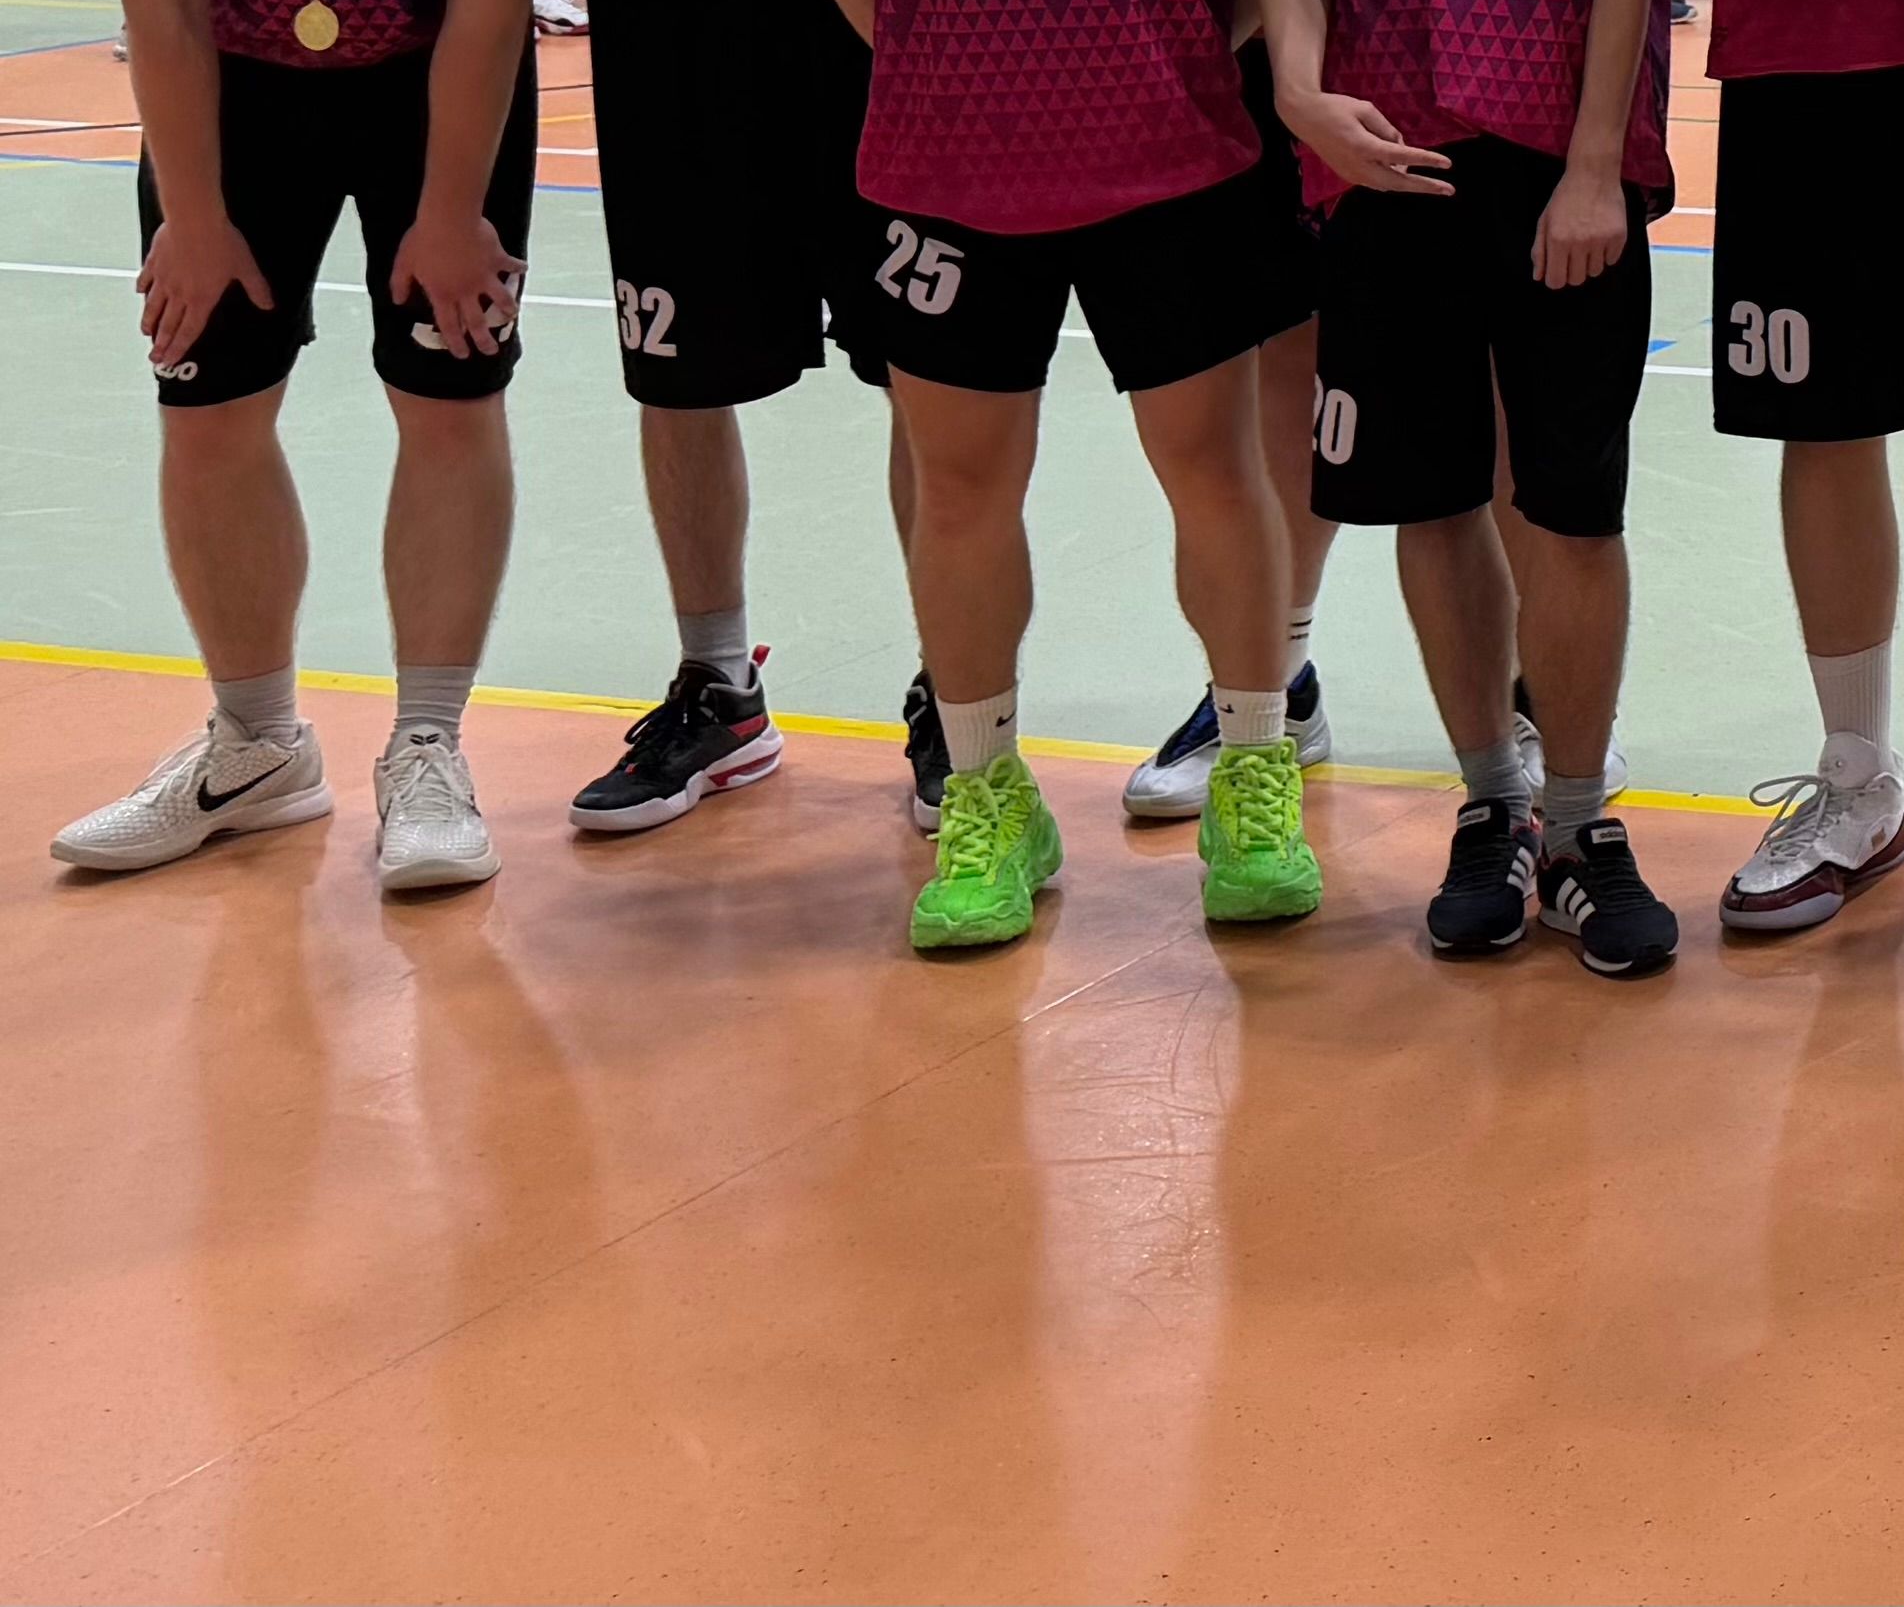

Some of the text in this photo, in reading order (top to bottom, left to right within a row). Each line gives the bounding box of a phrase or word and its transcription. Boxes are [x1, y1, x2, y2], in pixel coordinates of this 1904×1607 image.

[875, 218, 965, 315] 25
[616, 278, 678, 358] 32
[1728, 300, 1810, 384] 30
